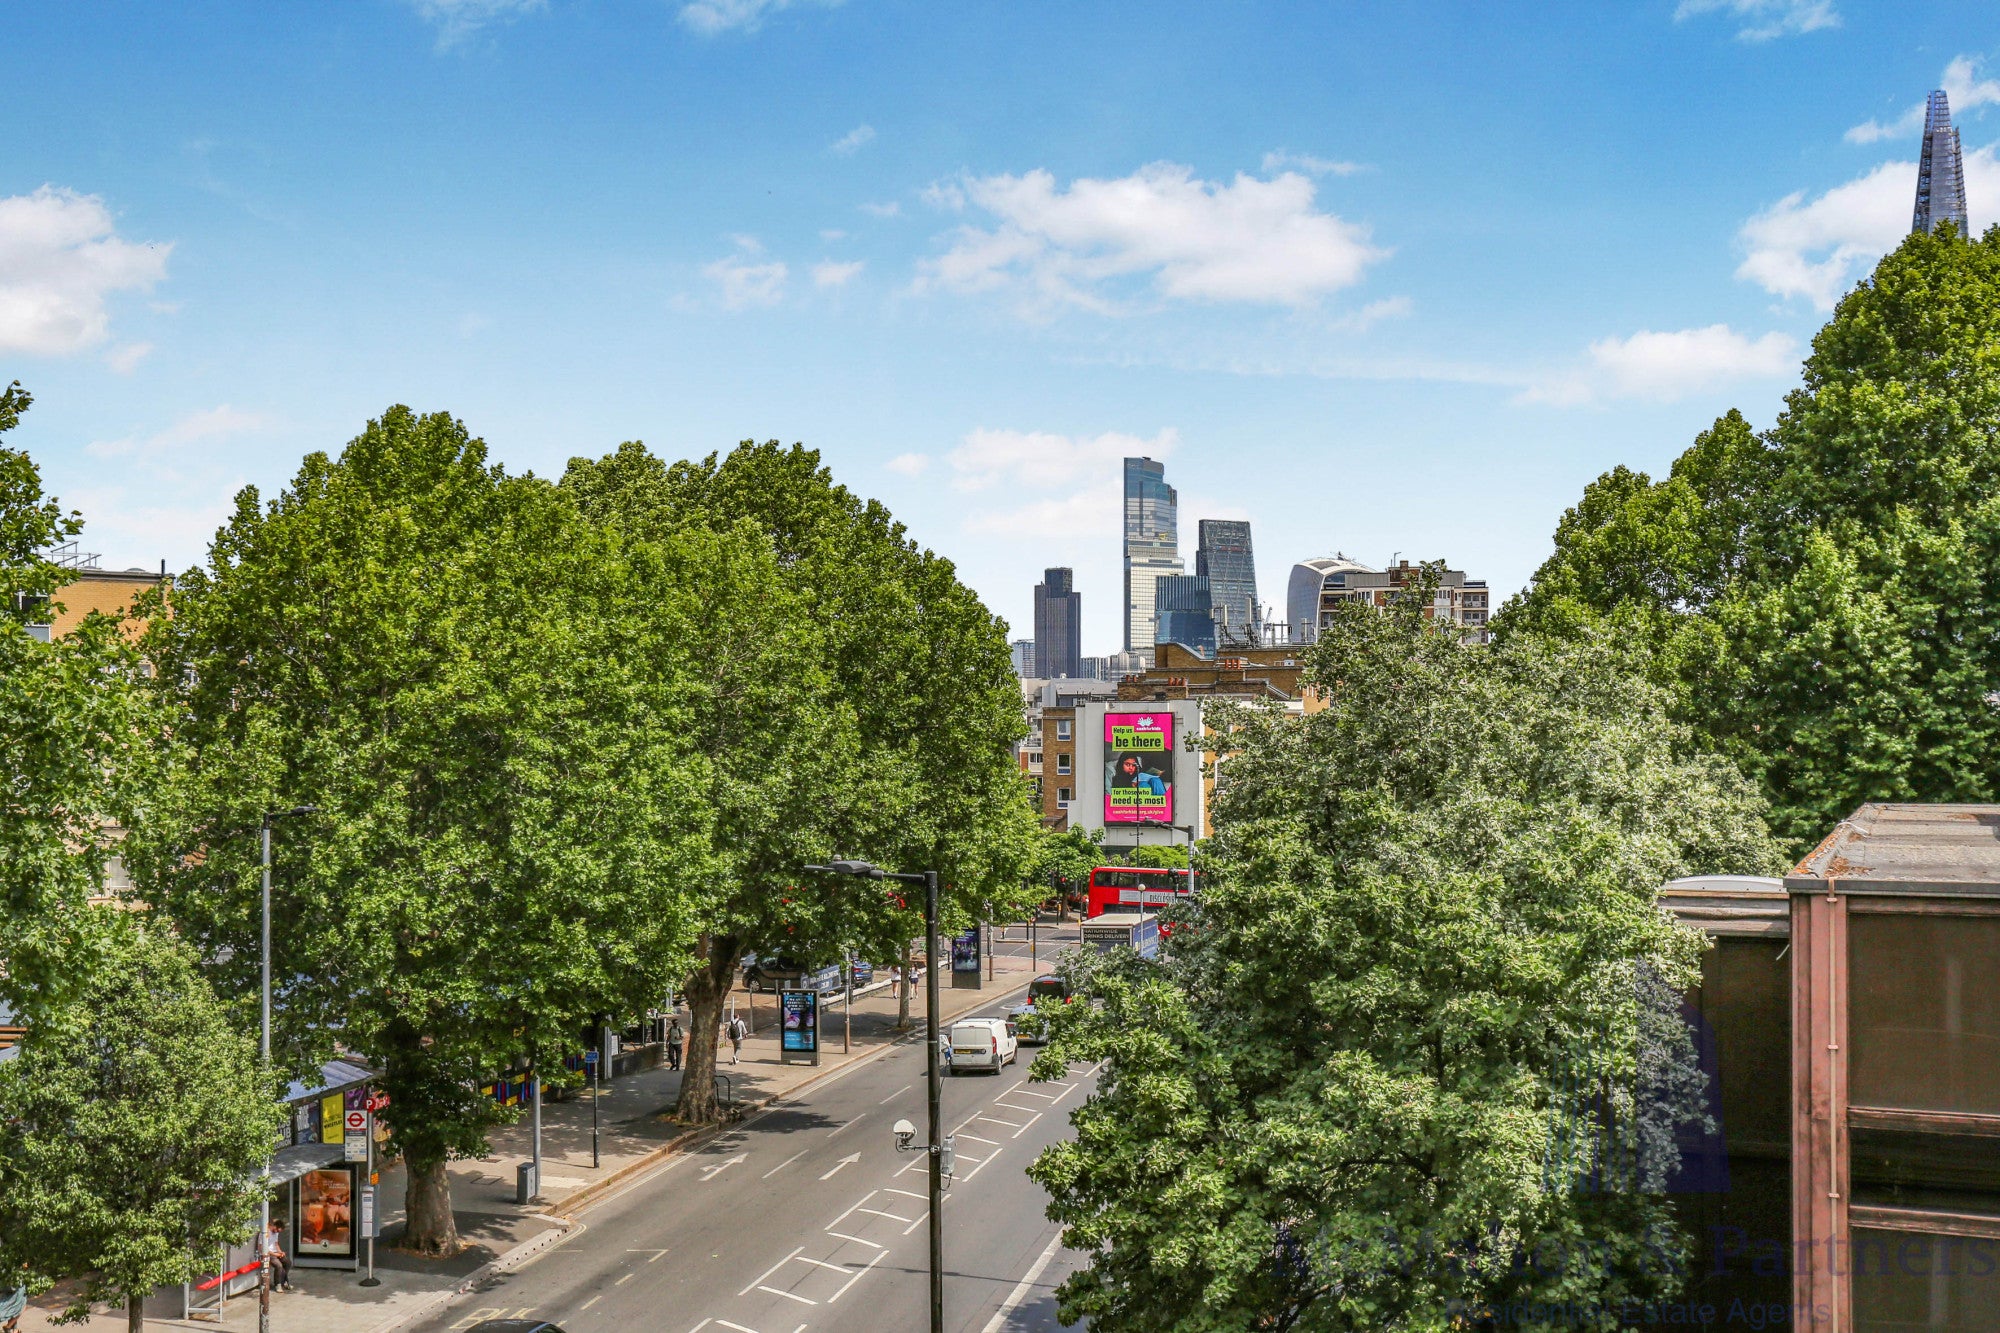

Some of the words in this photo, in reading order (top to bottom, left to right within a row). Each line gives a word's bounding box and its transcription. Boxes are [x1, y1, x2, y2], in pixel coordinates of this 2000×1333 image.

[1115, 736, 1129, 748] be
[1131, 736, 1161, 748] there
[1112, 796, 1131, 804] need
[366, 1099, 371, 1107] P
